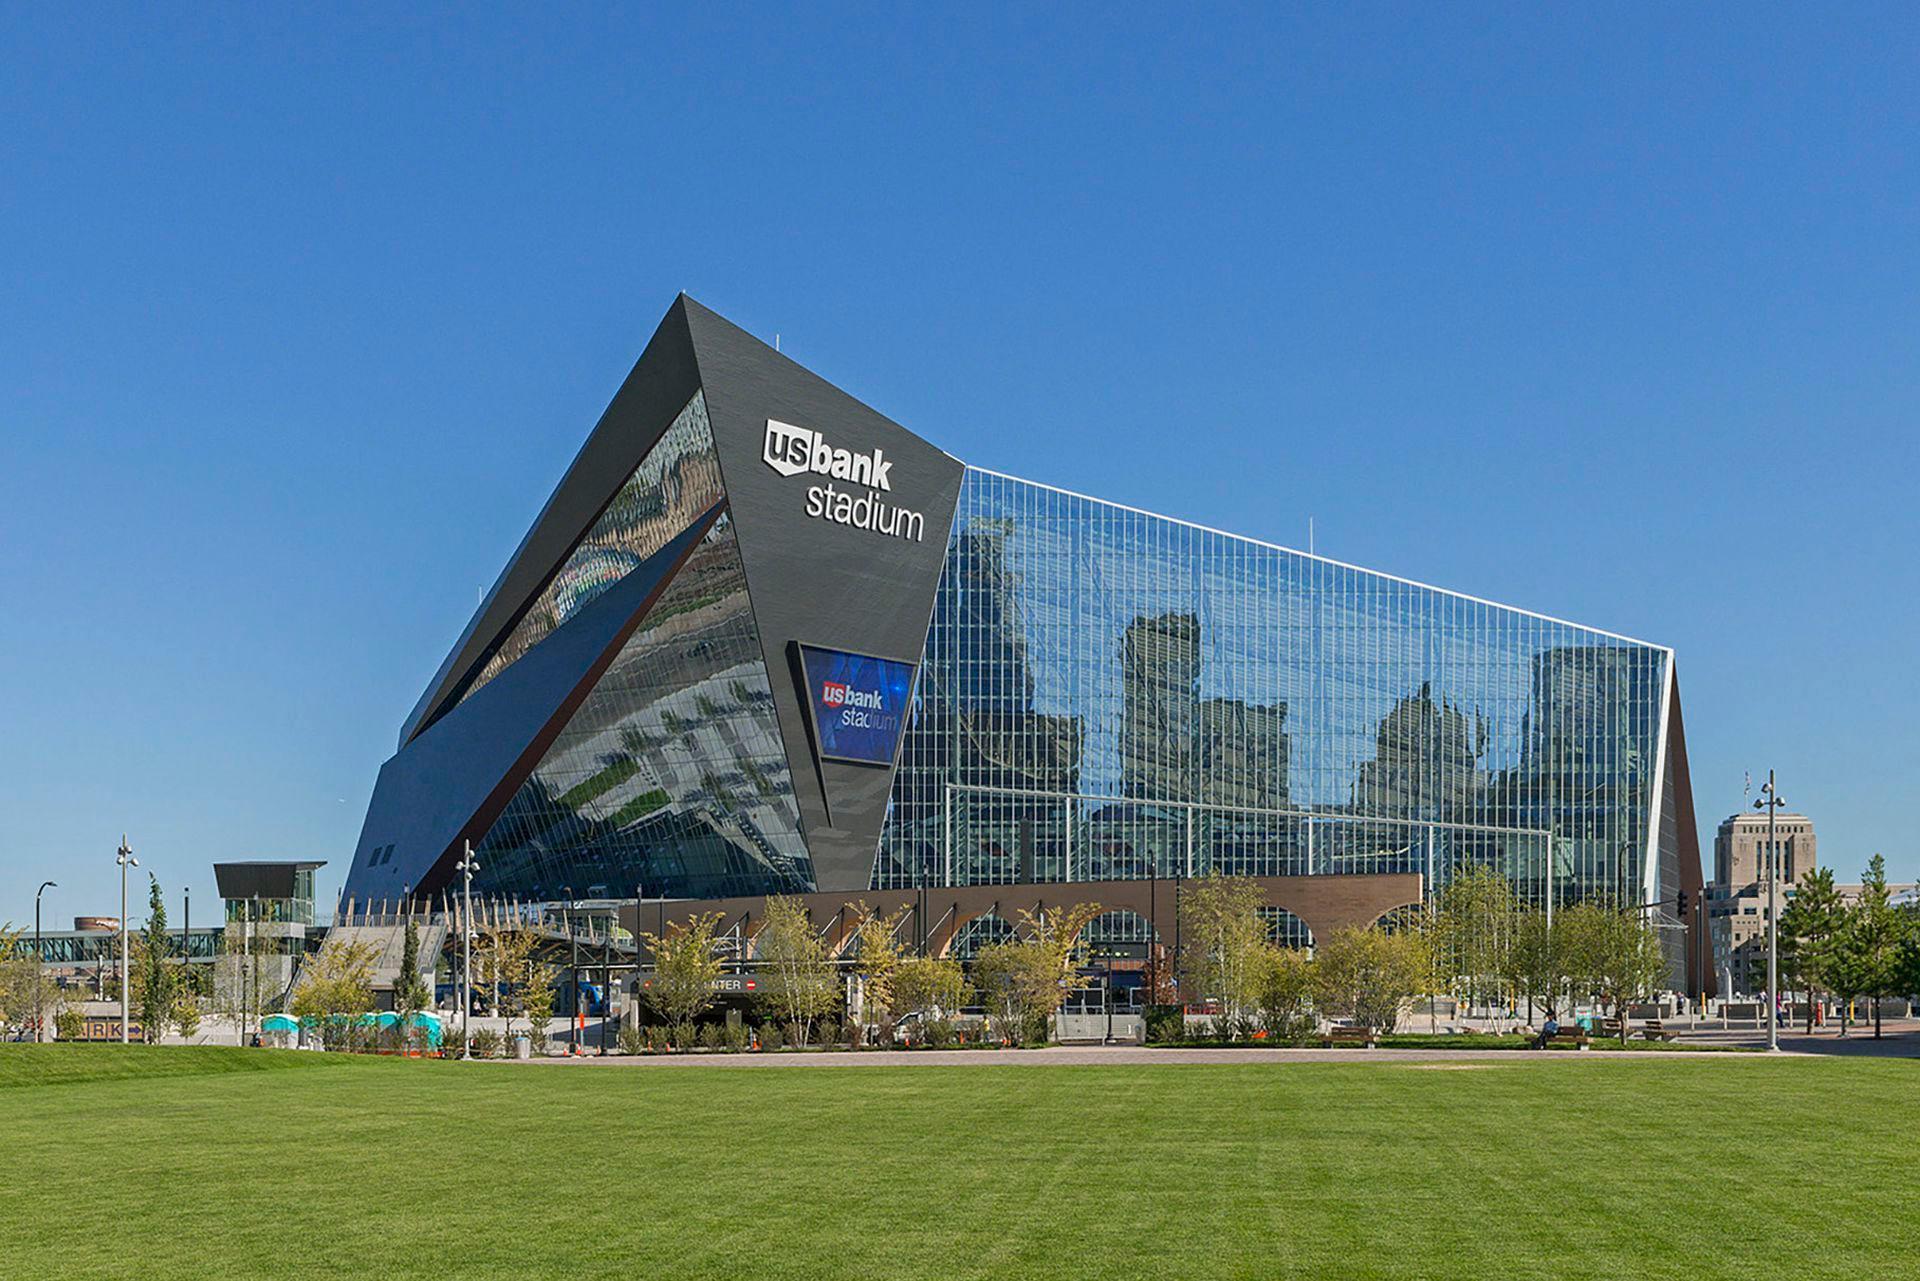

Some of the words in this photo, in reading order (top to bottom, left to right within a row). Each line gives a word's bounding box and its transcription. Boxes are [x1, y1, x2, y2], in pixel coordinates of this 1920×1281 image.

[806, 483, 924, 542] stadium
[841, 707, 897, 731] stadium
[704, 979, 741, 990] NTER
